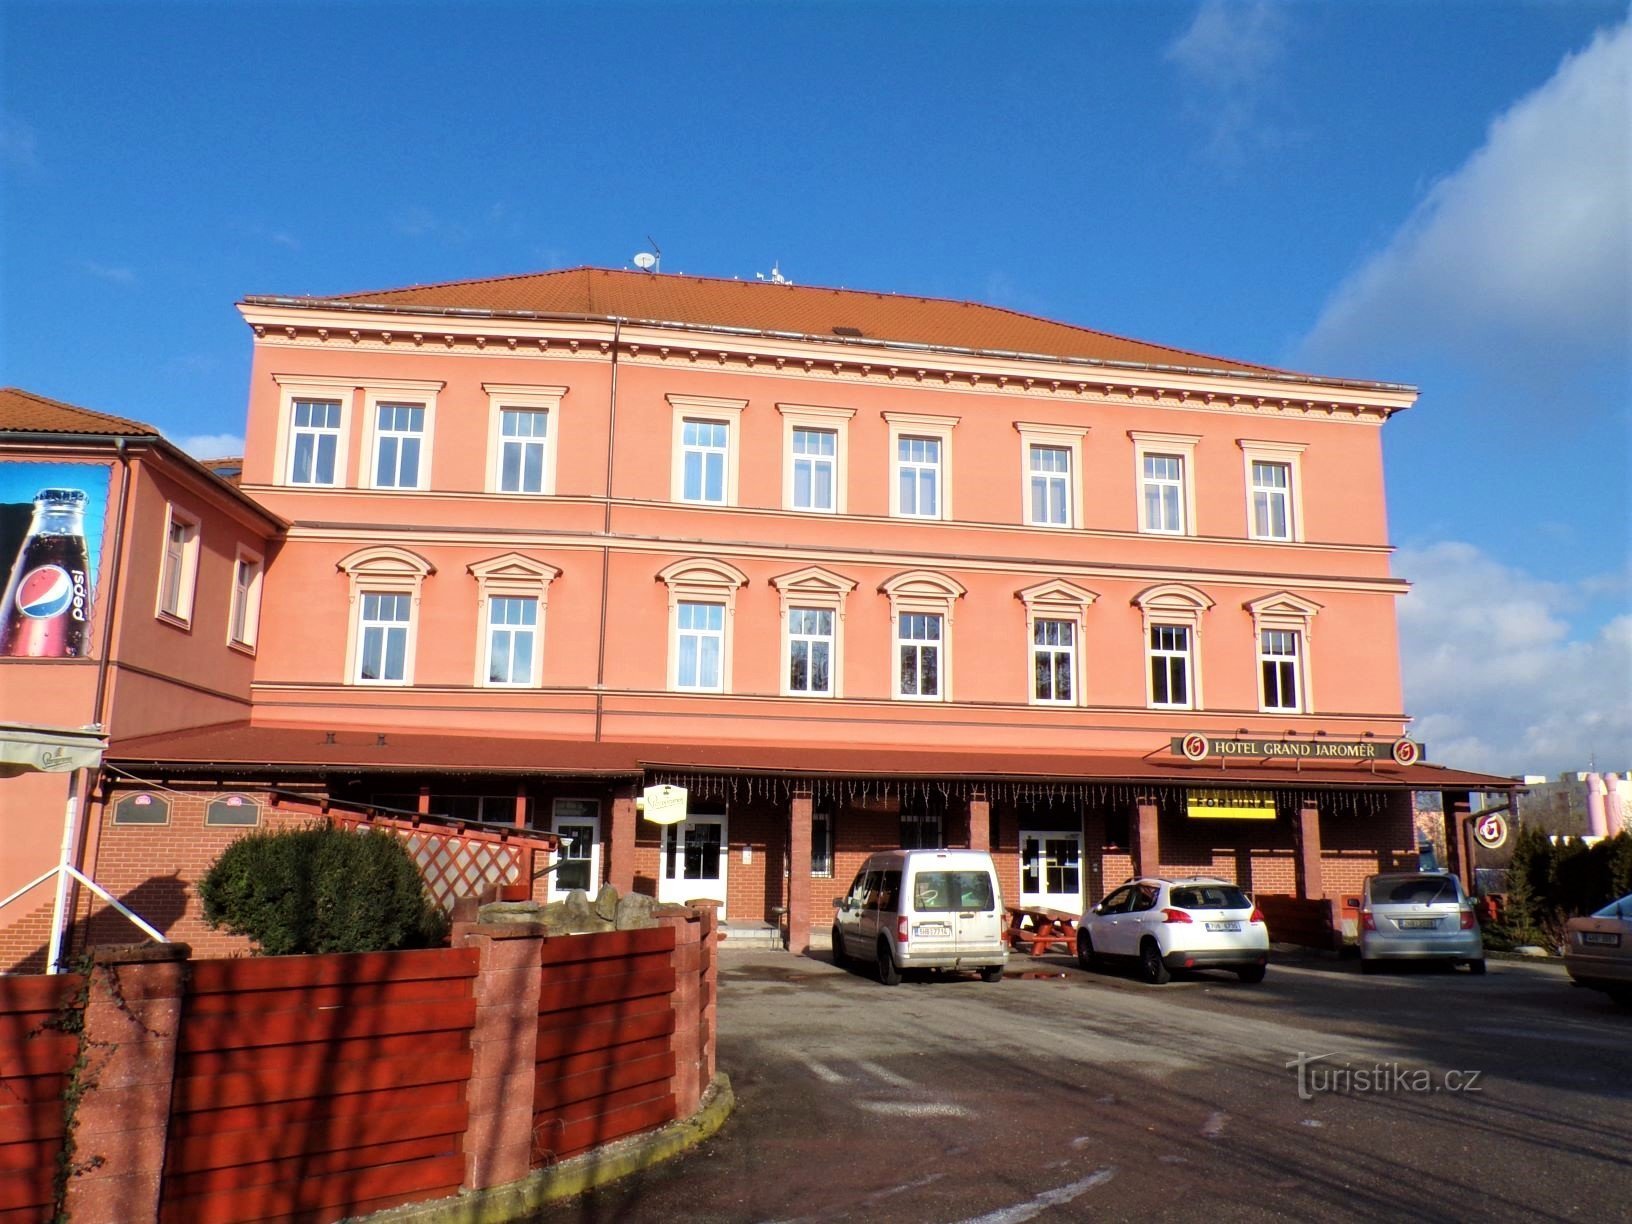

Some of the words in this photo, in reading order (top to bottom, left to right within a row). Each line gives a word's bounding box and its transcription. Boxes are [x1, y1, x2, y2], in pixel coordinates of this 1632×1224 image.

[72, 569, 86, 621] pepsi
[1215, 741, 1258, 754] HOTEL
[1263, 743, 1310, 756] GRAND
[1315, 743, 1375, 757] JAROMĚŘ
[1197, 798, 1266, 809] FORTUNA
